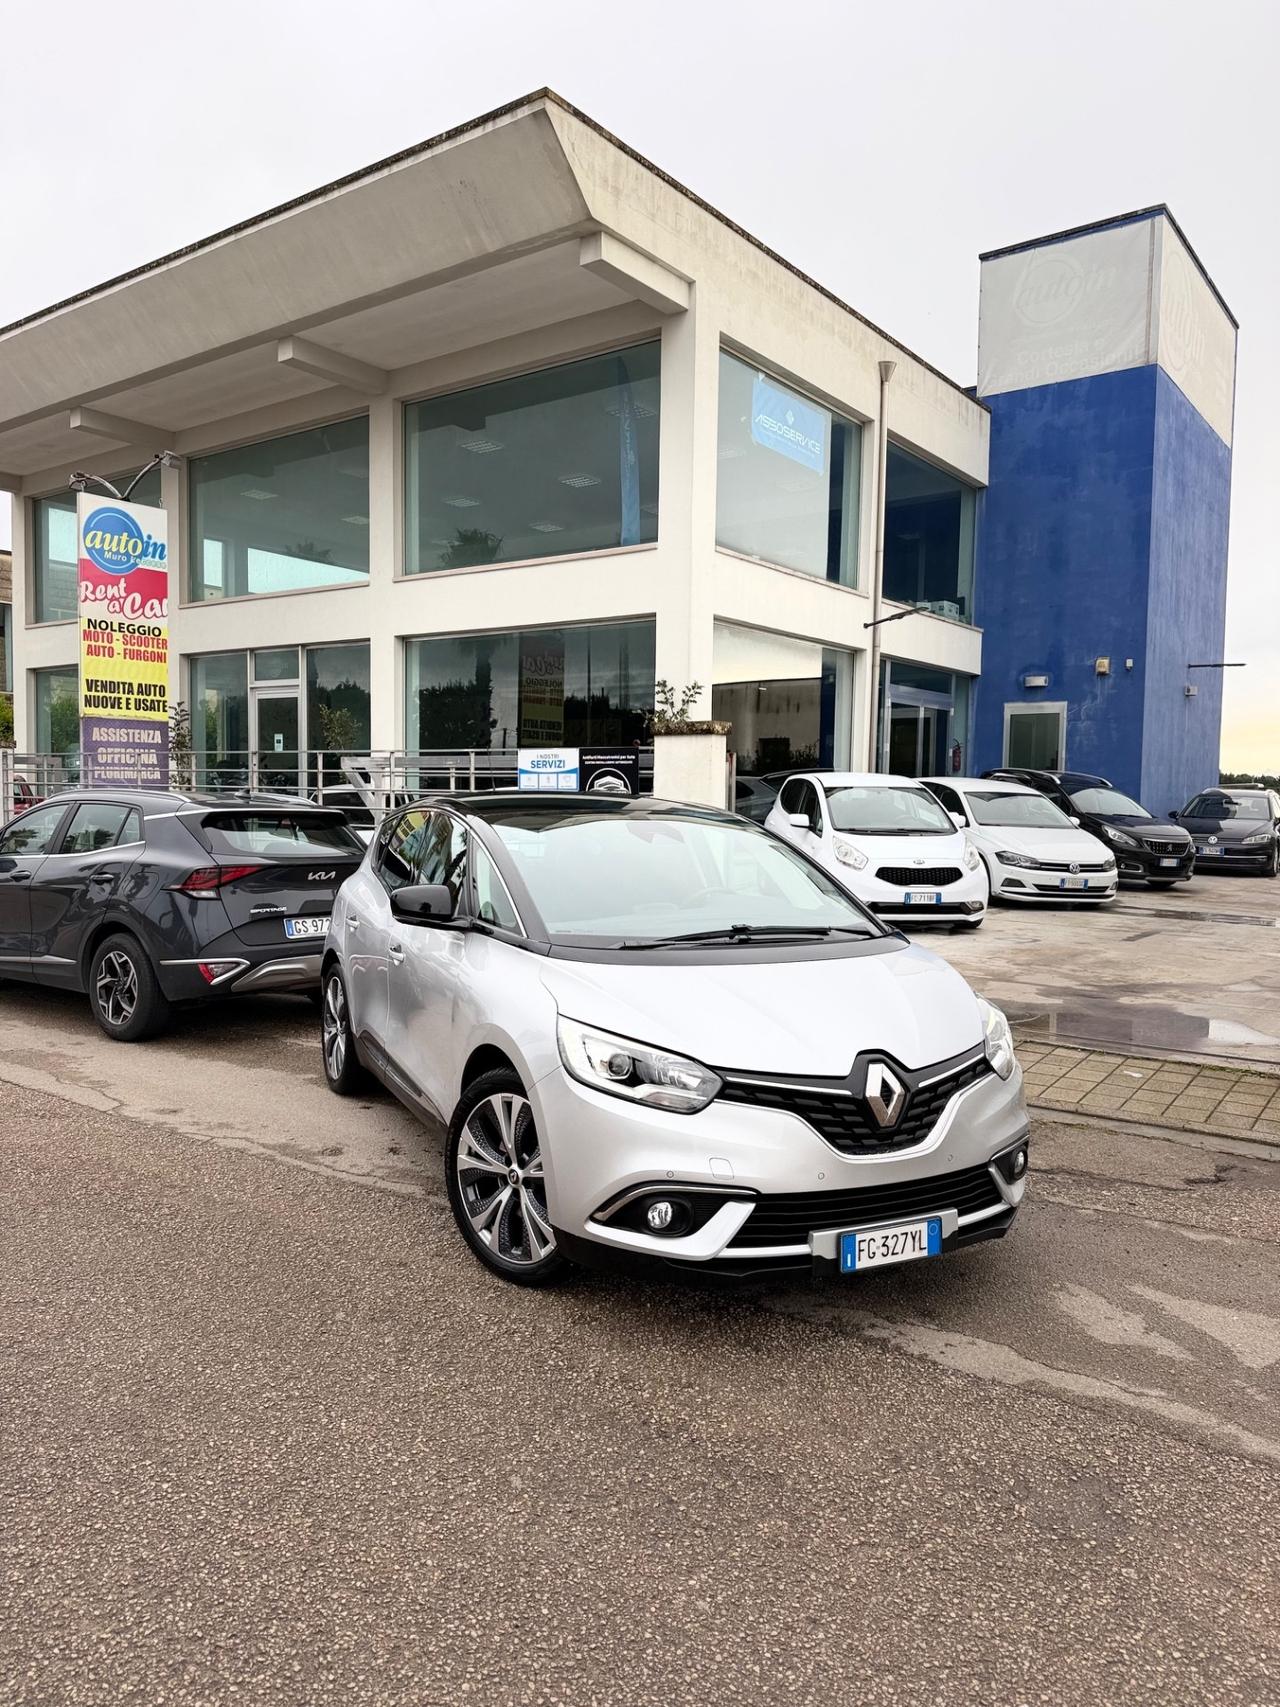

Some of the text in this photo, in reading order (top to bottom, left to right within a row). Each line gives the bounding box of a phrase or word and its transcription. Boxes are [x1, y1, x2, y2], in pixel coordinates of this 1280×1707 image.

[80, 577, 127, 602] Rent
[107, 600, 121, 614] a
[87, 618, 162, 638] NOLEGGIO
[82, 628, 114, 645] MOTO
[122, 633, 168, 651] SCOOTER
[86, 643, 115, 659] AUTO
[123, 647, 167, 664] FURGONI
[85, 678, 166, 698] VENDITA AUTO
[84, 694, 168, 713] NUOVE E USATE
[92, 727, 162, 744] ASSISTENZA
[97, 747, 158, 765] OFFICINA
[530, 759, 566, 770] SERVIZI
[294, 920, 309, 934] GS
